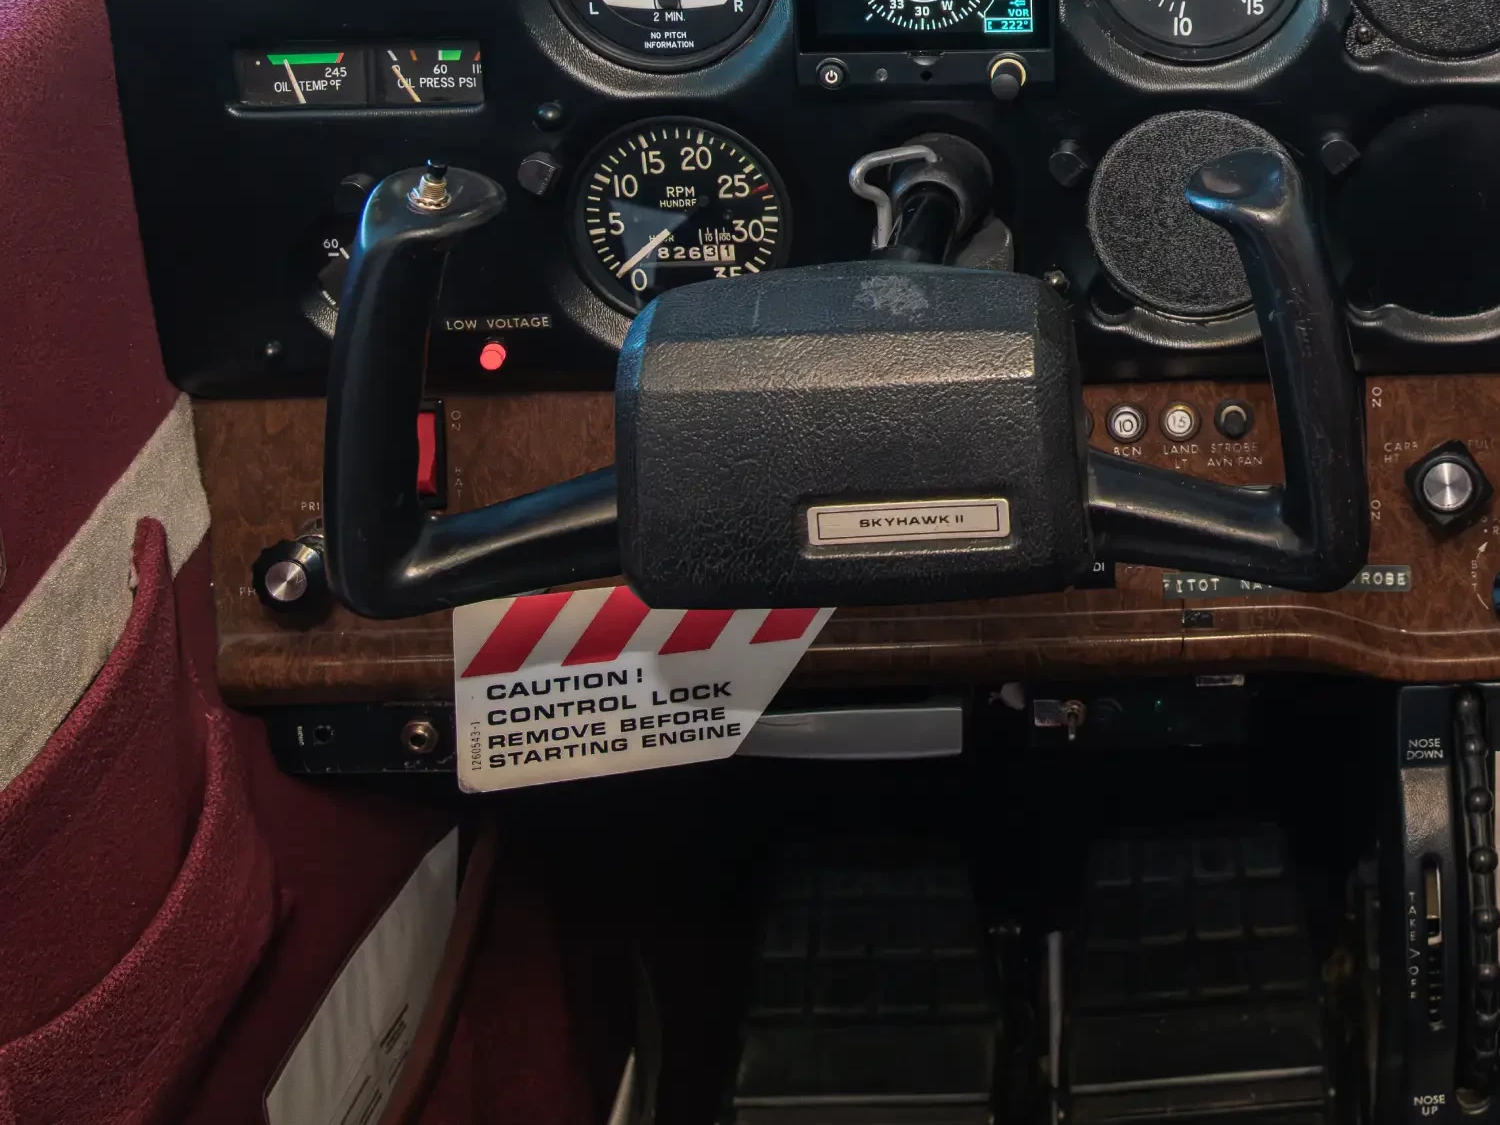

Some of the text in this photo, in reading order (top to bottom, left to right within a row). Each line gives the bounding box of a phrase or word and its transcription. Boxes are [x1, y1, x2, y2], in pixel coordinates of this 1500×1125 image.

[653, 12, 686, 21] 2 MIN.
[1008, 9, 1029, 17] VOR
[420, 77, 476, 88] PRESS PSI
[666, 187, 695, 197] RPM
[447, 316, 549, 331] LOW VOLTAGE
[1114, 447, 1141, 456] BCN
[1164, 445, 1199, 455] LAND
[860, 515, 964, 527] SKYHAWK II
[487, 668, 643, 700] CAUTION!
[488, 681, 733, 726] CONTROL LOCK
[488, 707, 725, 749] REMOVE BEFORE
[489, 723, 741, 768] STARTING ENGINE
[1408, 738, 1440, 749] NOSE
[1407, 749, 1443, 759] DOWN
[1414, 1095, 1445, 1105] NOSE
[1422, 1105, 1437, 1115] UP
